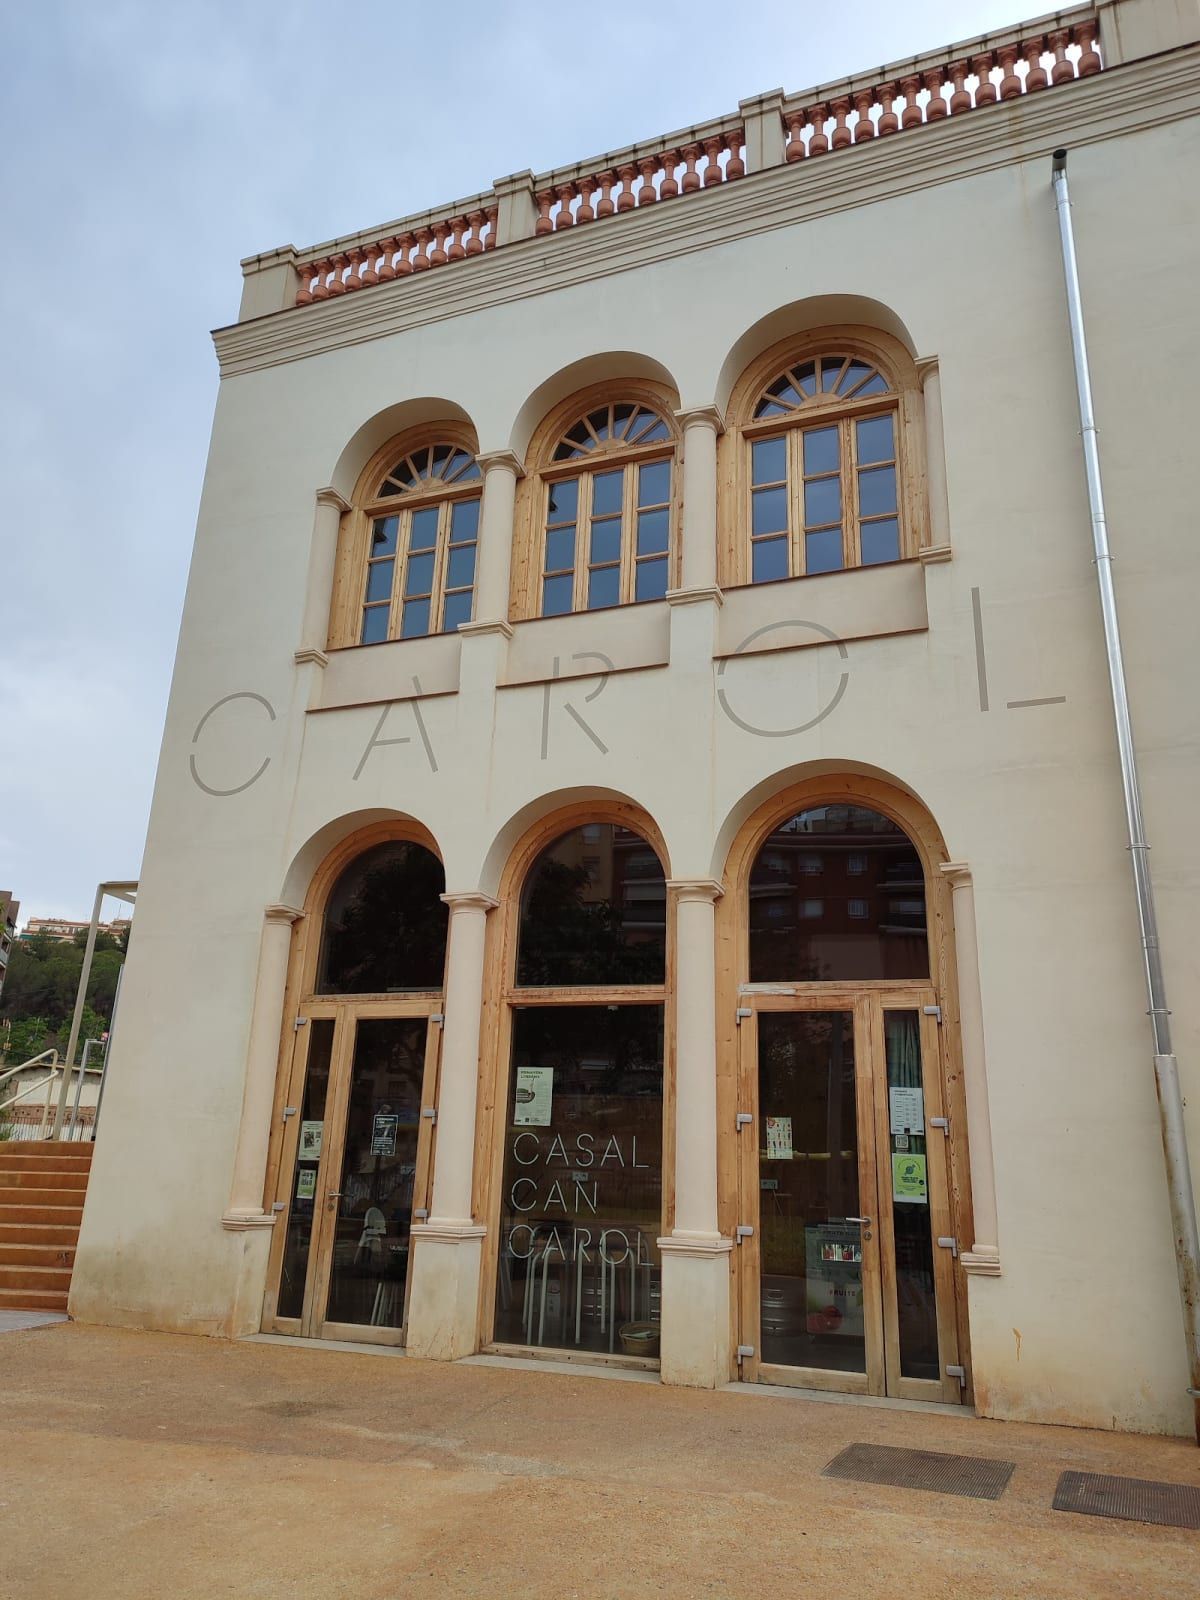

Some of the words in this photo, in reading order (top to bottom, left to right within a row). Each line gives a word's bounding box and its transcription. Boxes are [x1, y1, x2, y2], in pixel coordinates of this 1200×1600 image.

[190, 587, 1067, 797] CAROL
[513, 1132, 649, 1168] CASAL
[511, 1178, 598, 1214] CAN
[508, 1224, 655, 1266] CAROL
